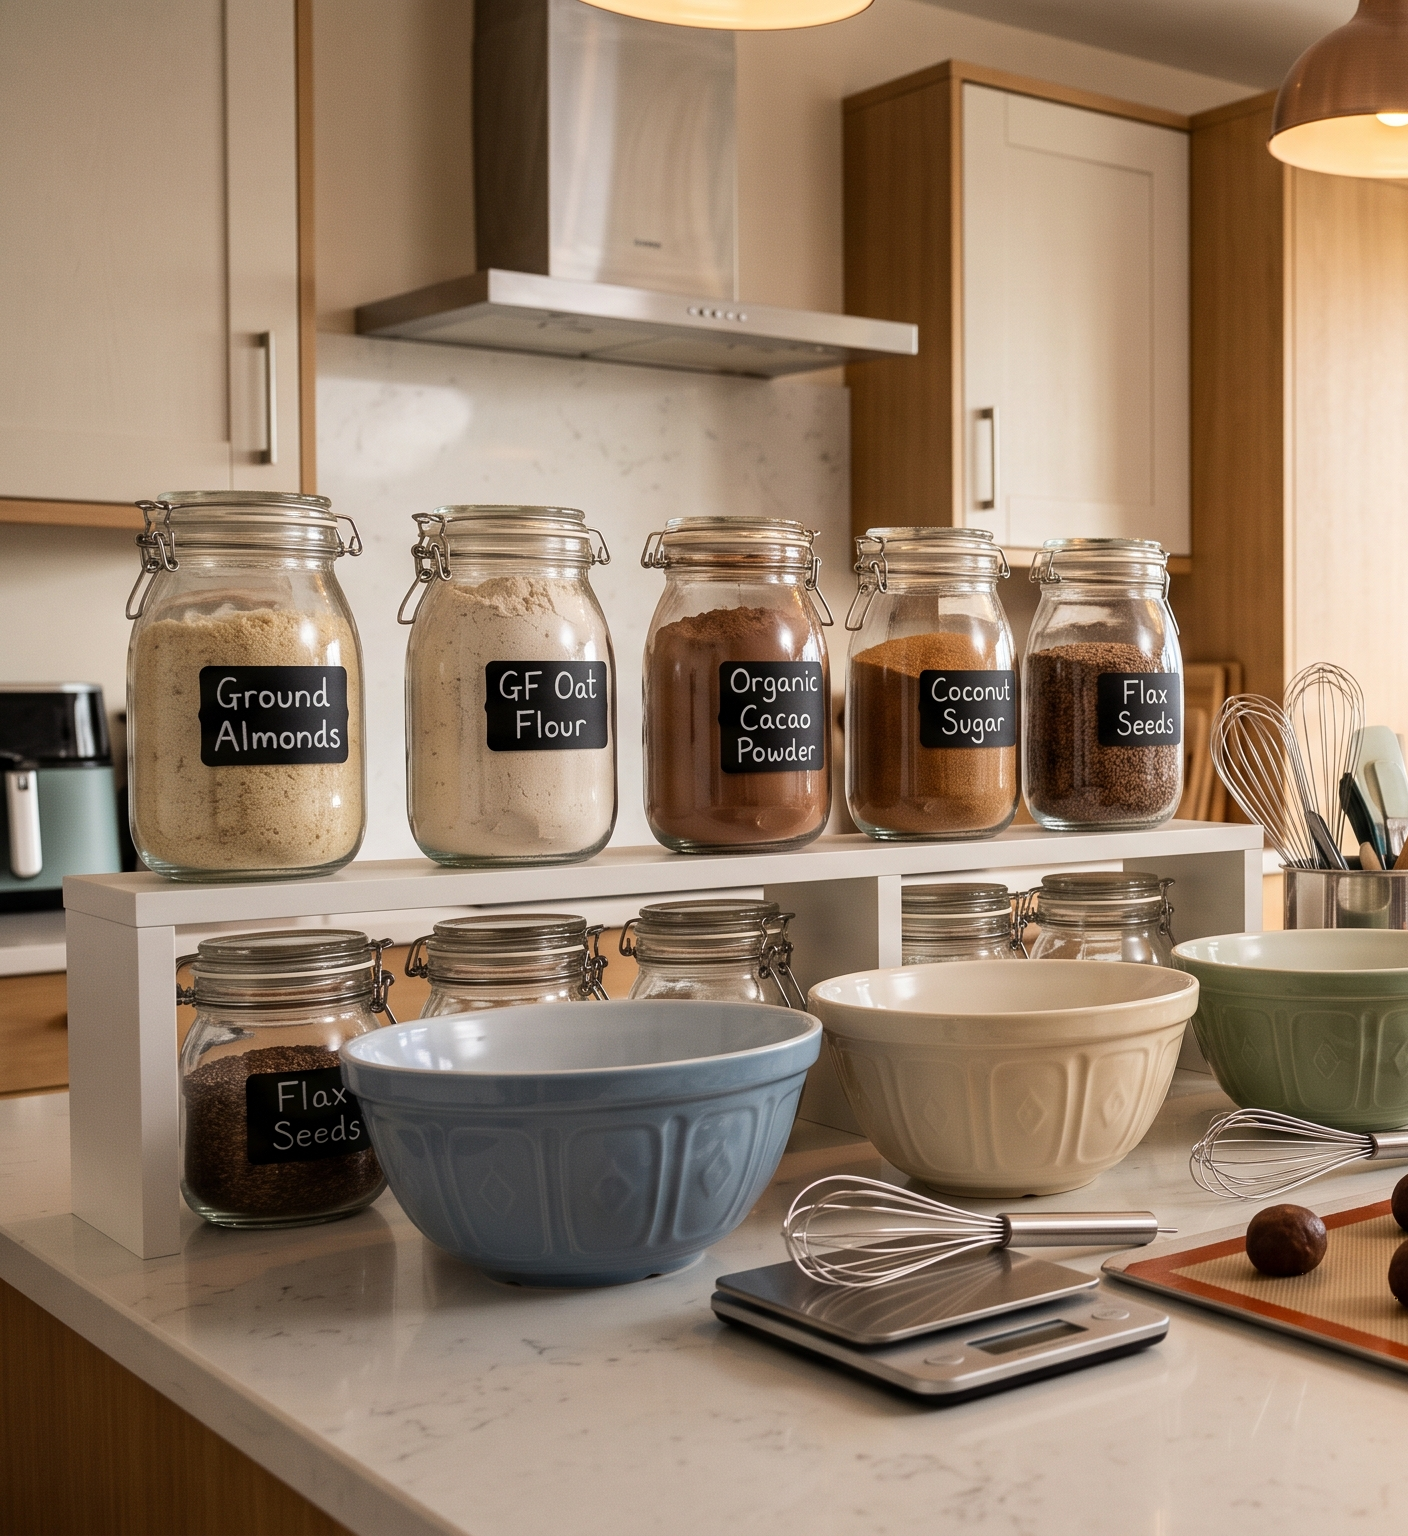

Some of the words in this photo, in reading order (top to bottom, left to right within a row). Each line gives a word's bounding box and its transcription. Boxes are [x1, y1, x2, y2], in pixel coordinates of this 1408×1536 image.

[217, 677, 330, 710] Ground
[500, 671, 542, 701] GF
[555, 669, 597, 699] Oat
[731, 669, 818, 702] Organic
[932, 678, 1010, 701] Coconut
[1124, 677, 1170, 704] Flax
[517, 710, 586, 738] Flour
[741, 705, 811, 730] Cacao
[942, 709, 1004, 743] Sugar
[1118, 709, 1175, 735] Seeds
[215, 719, 340, 751] Almonds
[738, 737, 815, 762] Powder
[278, 1080, 347, 1112] Flax
[272, 1114, 361, 1150] Seeds
